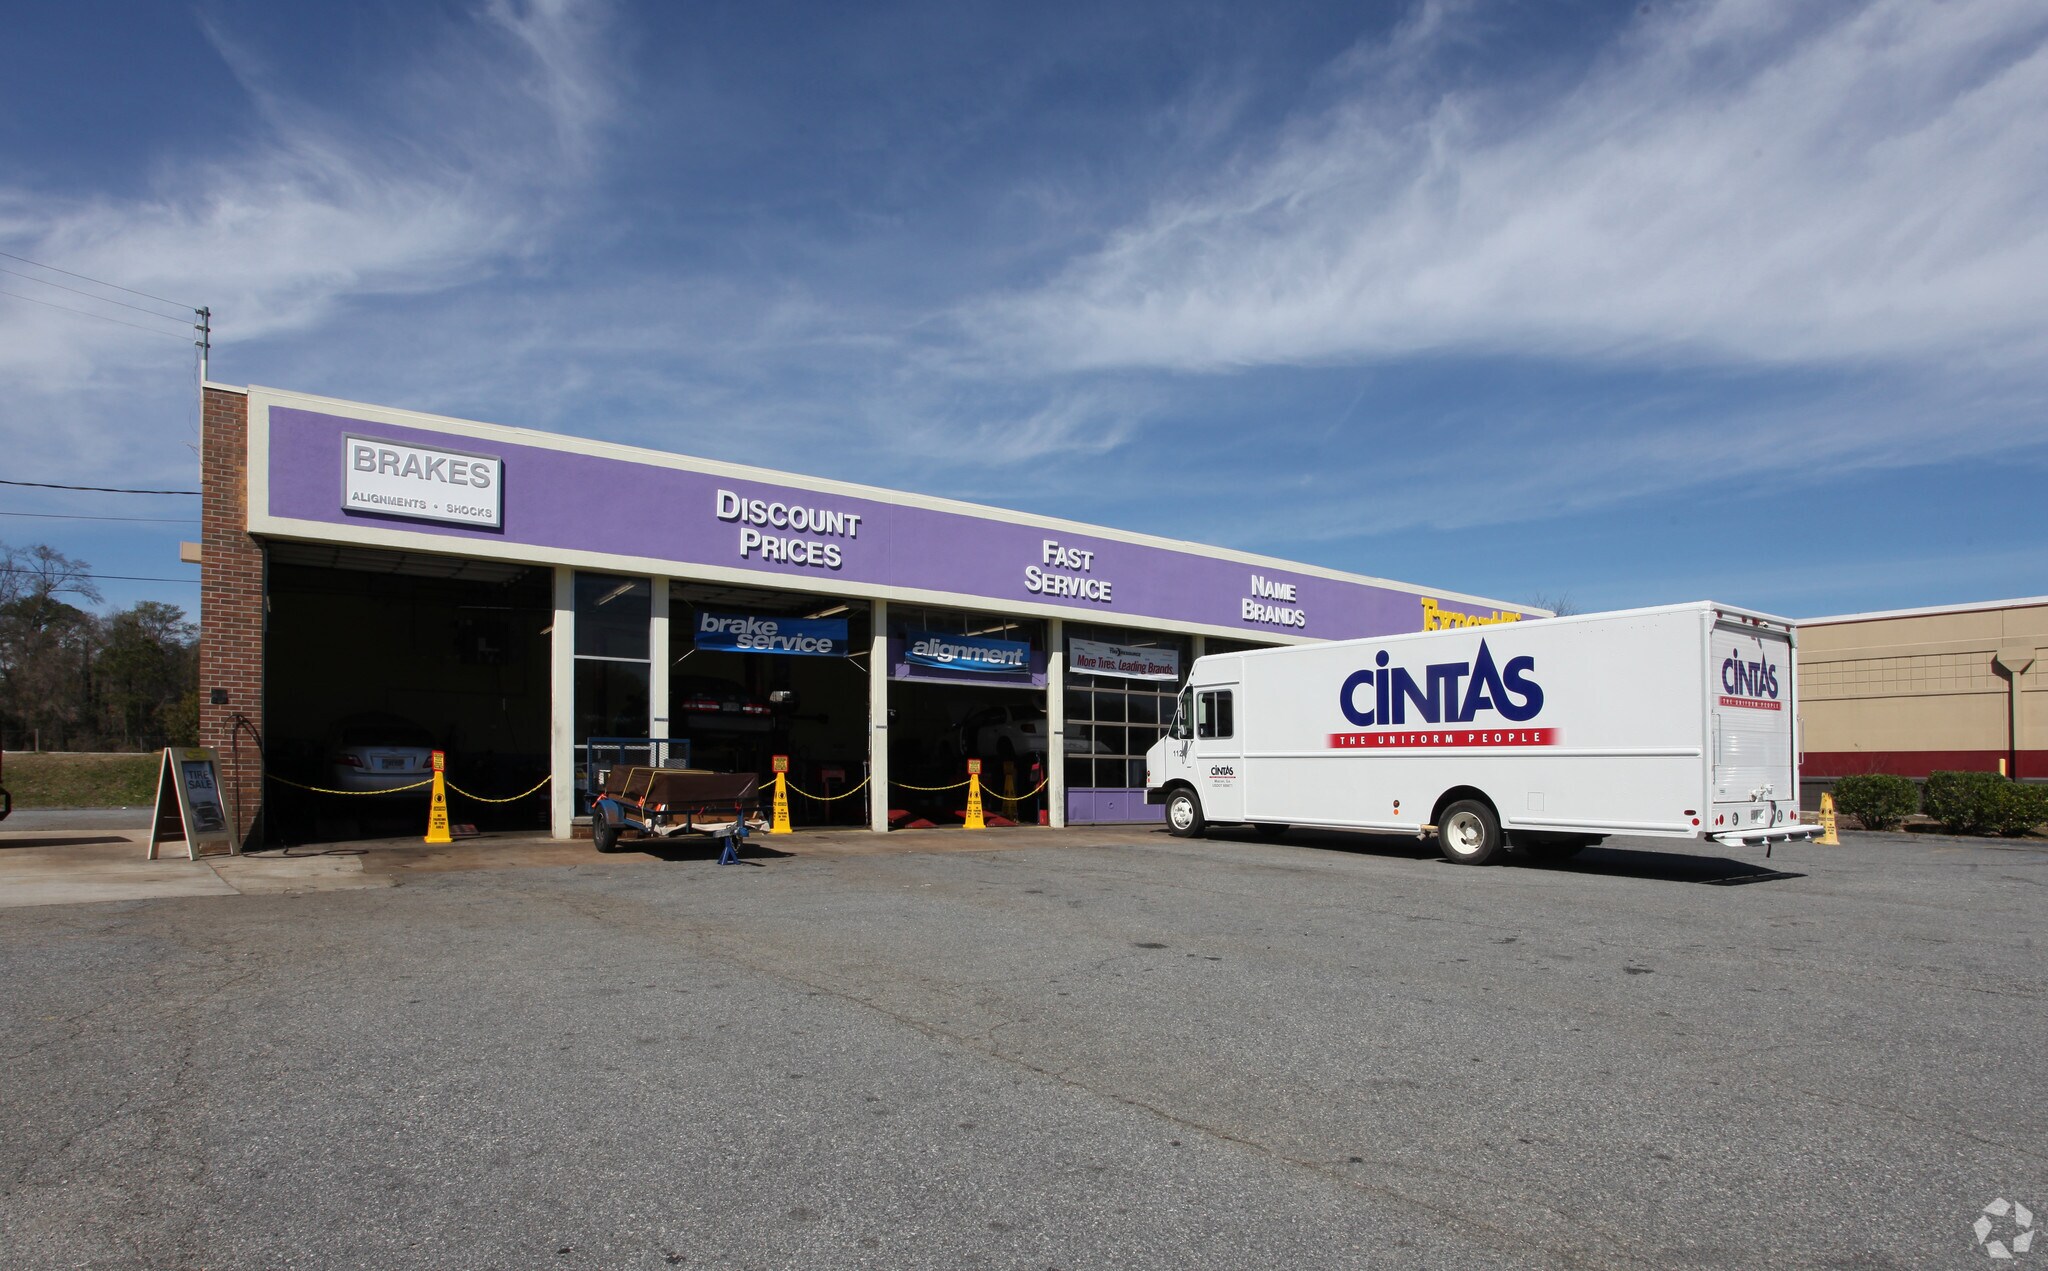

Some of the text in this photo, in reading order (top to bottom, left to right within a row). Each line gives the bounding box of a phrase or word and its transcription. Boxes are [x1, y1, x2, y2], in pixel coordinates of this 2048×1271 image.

[354, 445, 490, 488] BRAKES
[352, 491, 492, 518] ALIGNMENTS SHOCKS
[716, 489, 861, 537] DISCOUNT
[740, 527, 842, 568] PRICES
[1042, 539, 1094, 571] FAST
[1024, 565, 1112, 602] SERVICE
[1251, 574, 1296, 602] NAME
[700, 613, 778, 636] brake
[1242, 597, 1305, 628] BRANDS
[736, 633, 833, 654] service
[913, 638, 1023, 665] alignment
[1077, 654, 1174, 675] More Tires. Leading Brands.
[1340, 732, 1540, 745] THE UNIFORM PEOPLE
[189, 771, 208, 779] TIRE
[189, 780, 212, 789] SALE
